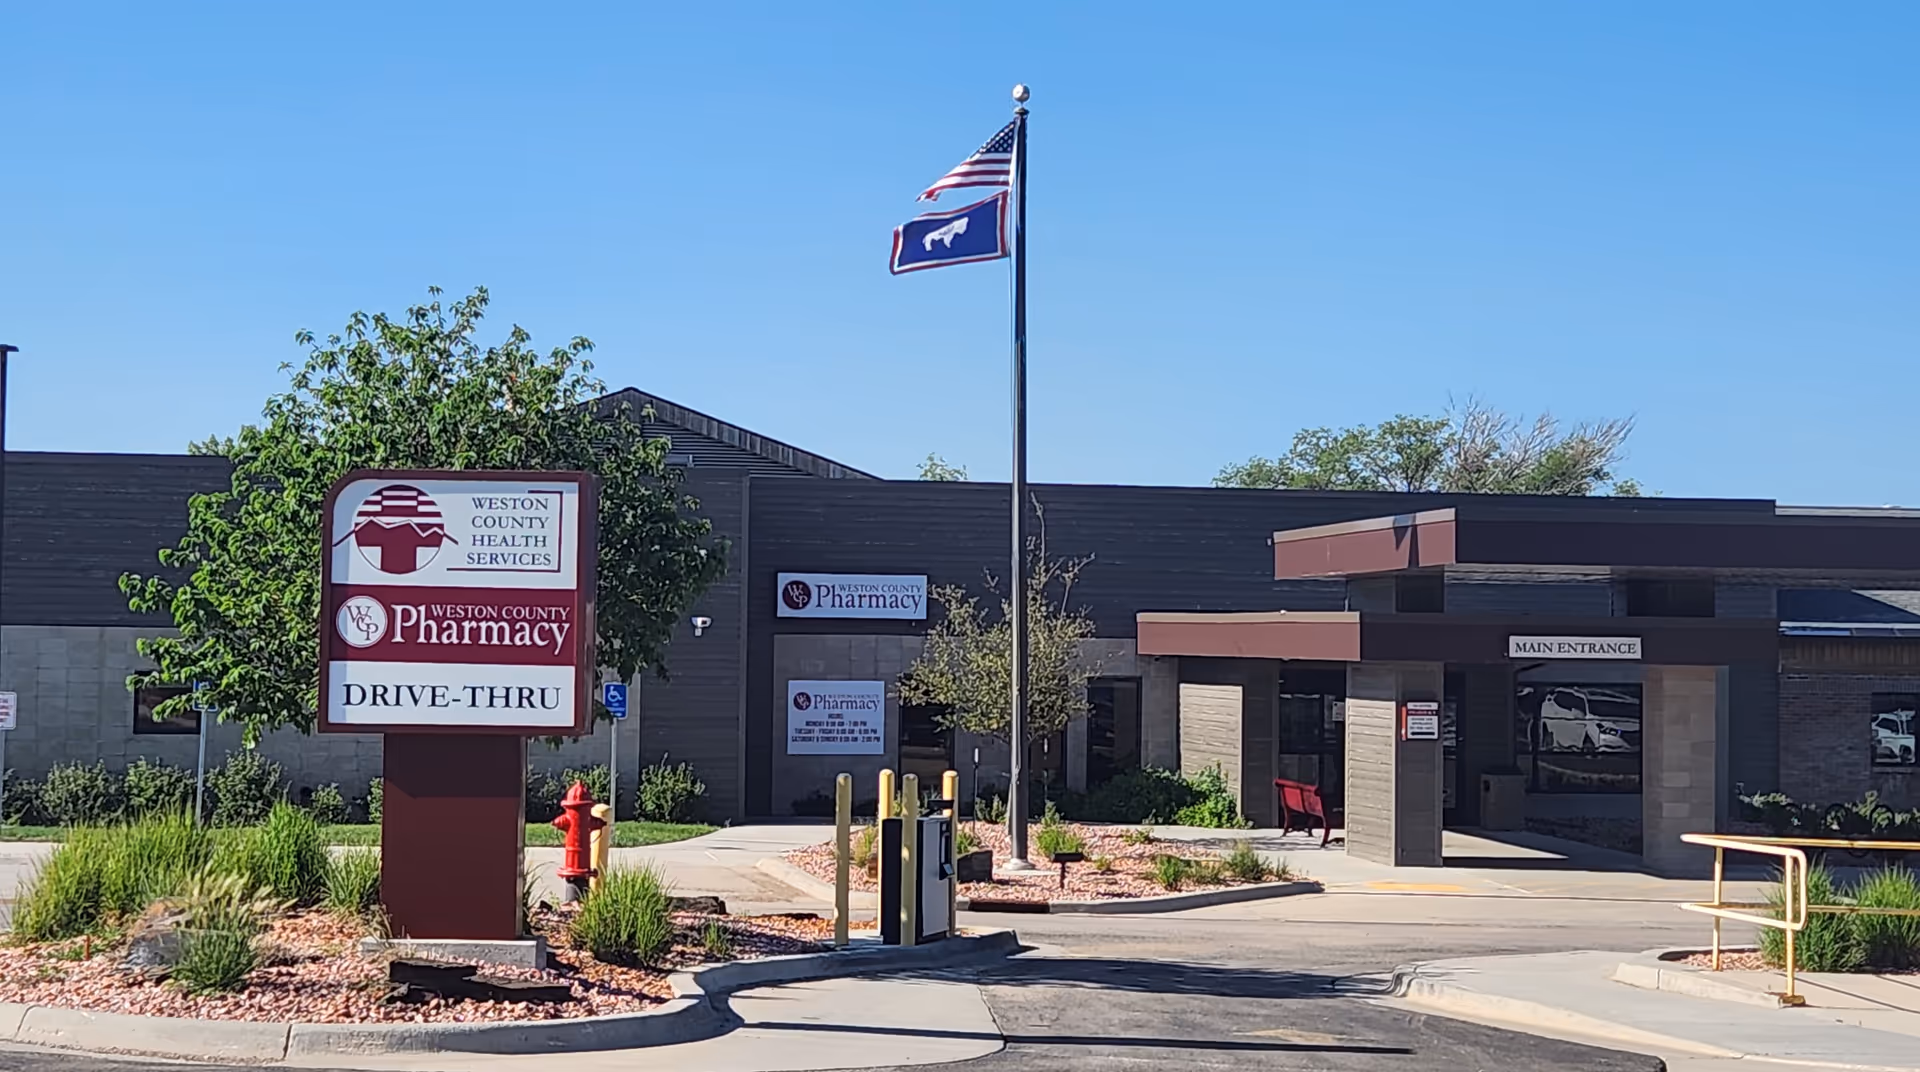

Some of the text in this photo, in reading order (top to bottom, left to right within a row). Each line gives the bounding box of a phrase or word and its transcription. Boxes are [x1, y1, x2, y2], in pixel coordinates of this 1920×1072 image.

[471, 497, 549, 510] WESTON
[471, 515, 550, 529] COUNTY
[471, 534, 547, 547] HEALTH
[466, 552, 551, 566] SERVICES
[838, 584, 922, 592] WESTON COUNTY
[815, 584, 922, 614] Pharmacy
[431, 604, 570, 620] WESTON COUNTY
[390, 604, 570, 656] Pharmacy
[1515, 642, 1636, 654] MAIN ENTRANCE
[342, 683, 561, 709] DRIVE-THRU
[813, 694, 880, 712] Pharmacy
